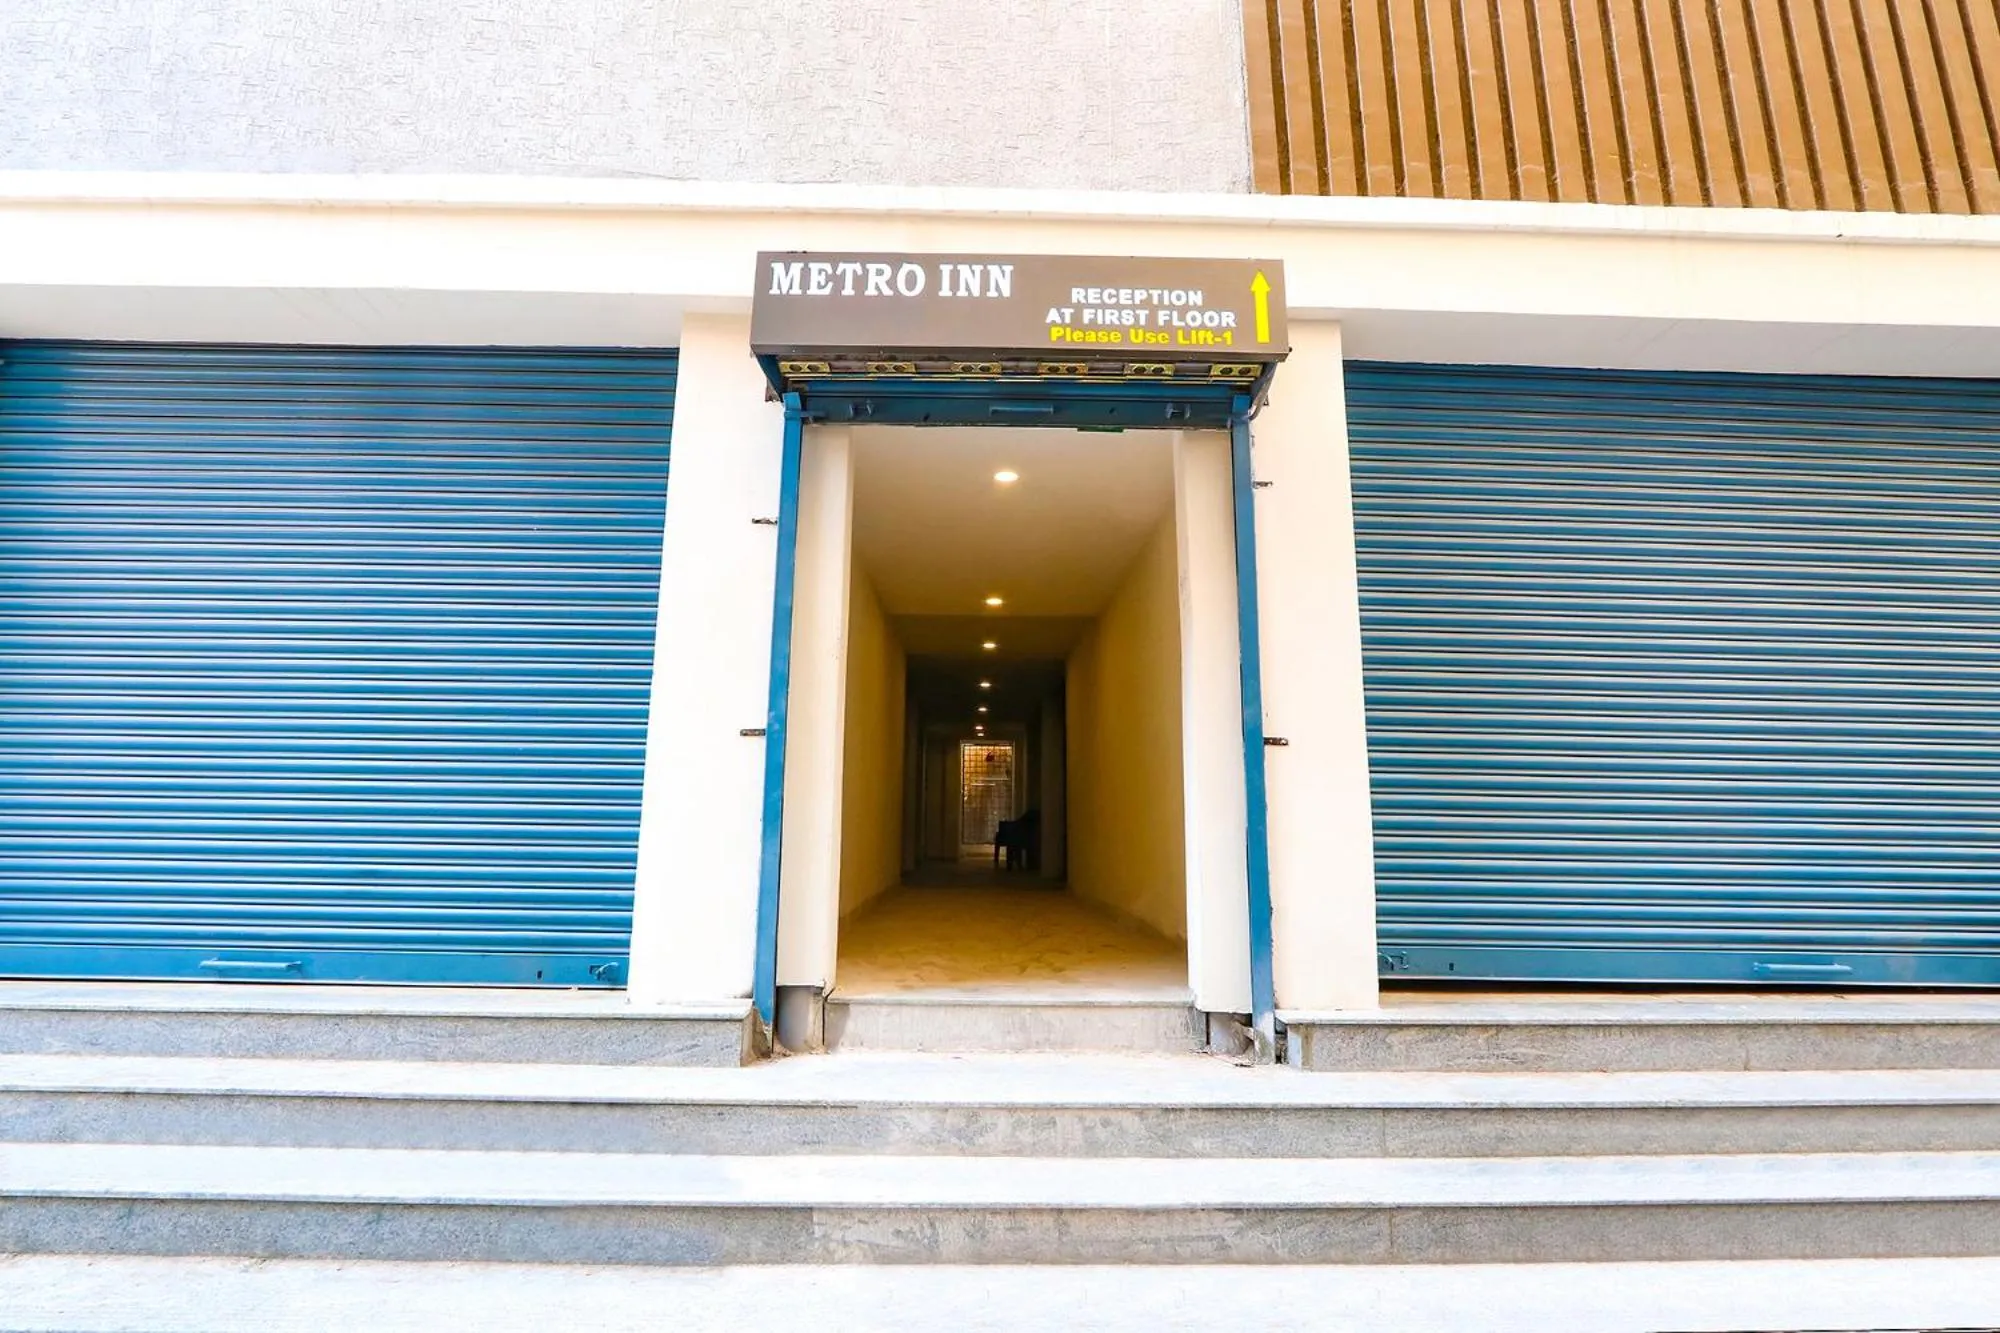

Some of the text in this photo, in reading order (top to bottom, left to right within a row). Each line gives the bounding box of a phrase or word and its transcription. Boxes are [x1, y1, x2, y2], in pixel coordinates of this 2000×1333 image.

[768, 261, 1014, 298] METRO INN
[1071, 287, 1203, 306] RECEPTION
[1045, 307, 1237, 328] AT FIRST FLOOR
[1049, 325, 1233, 347] Please Use Lift-1
